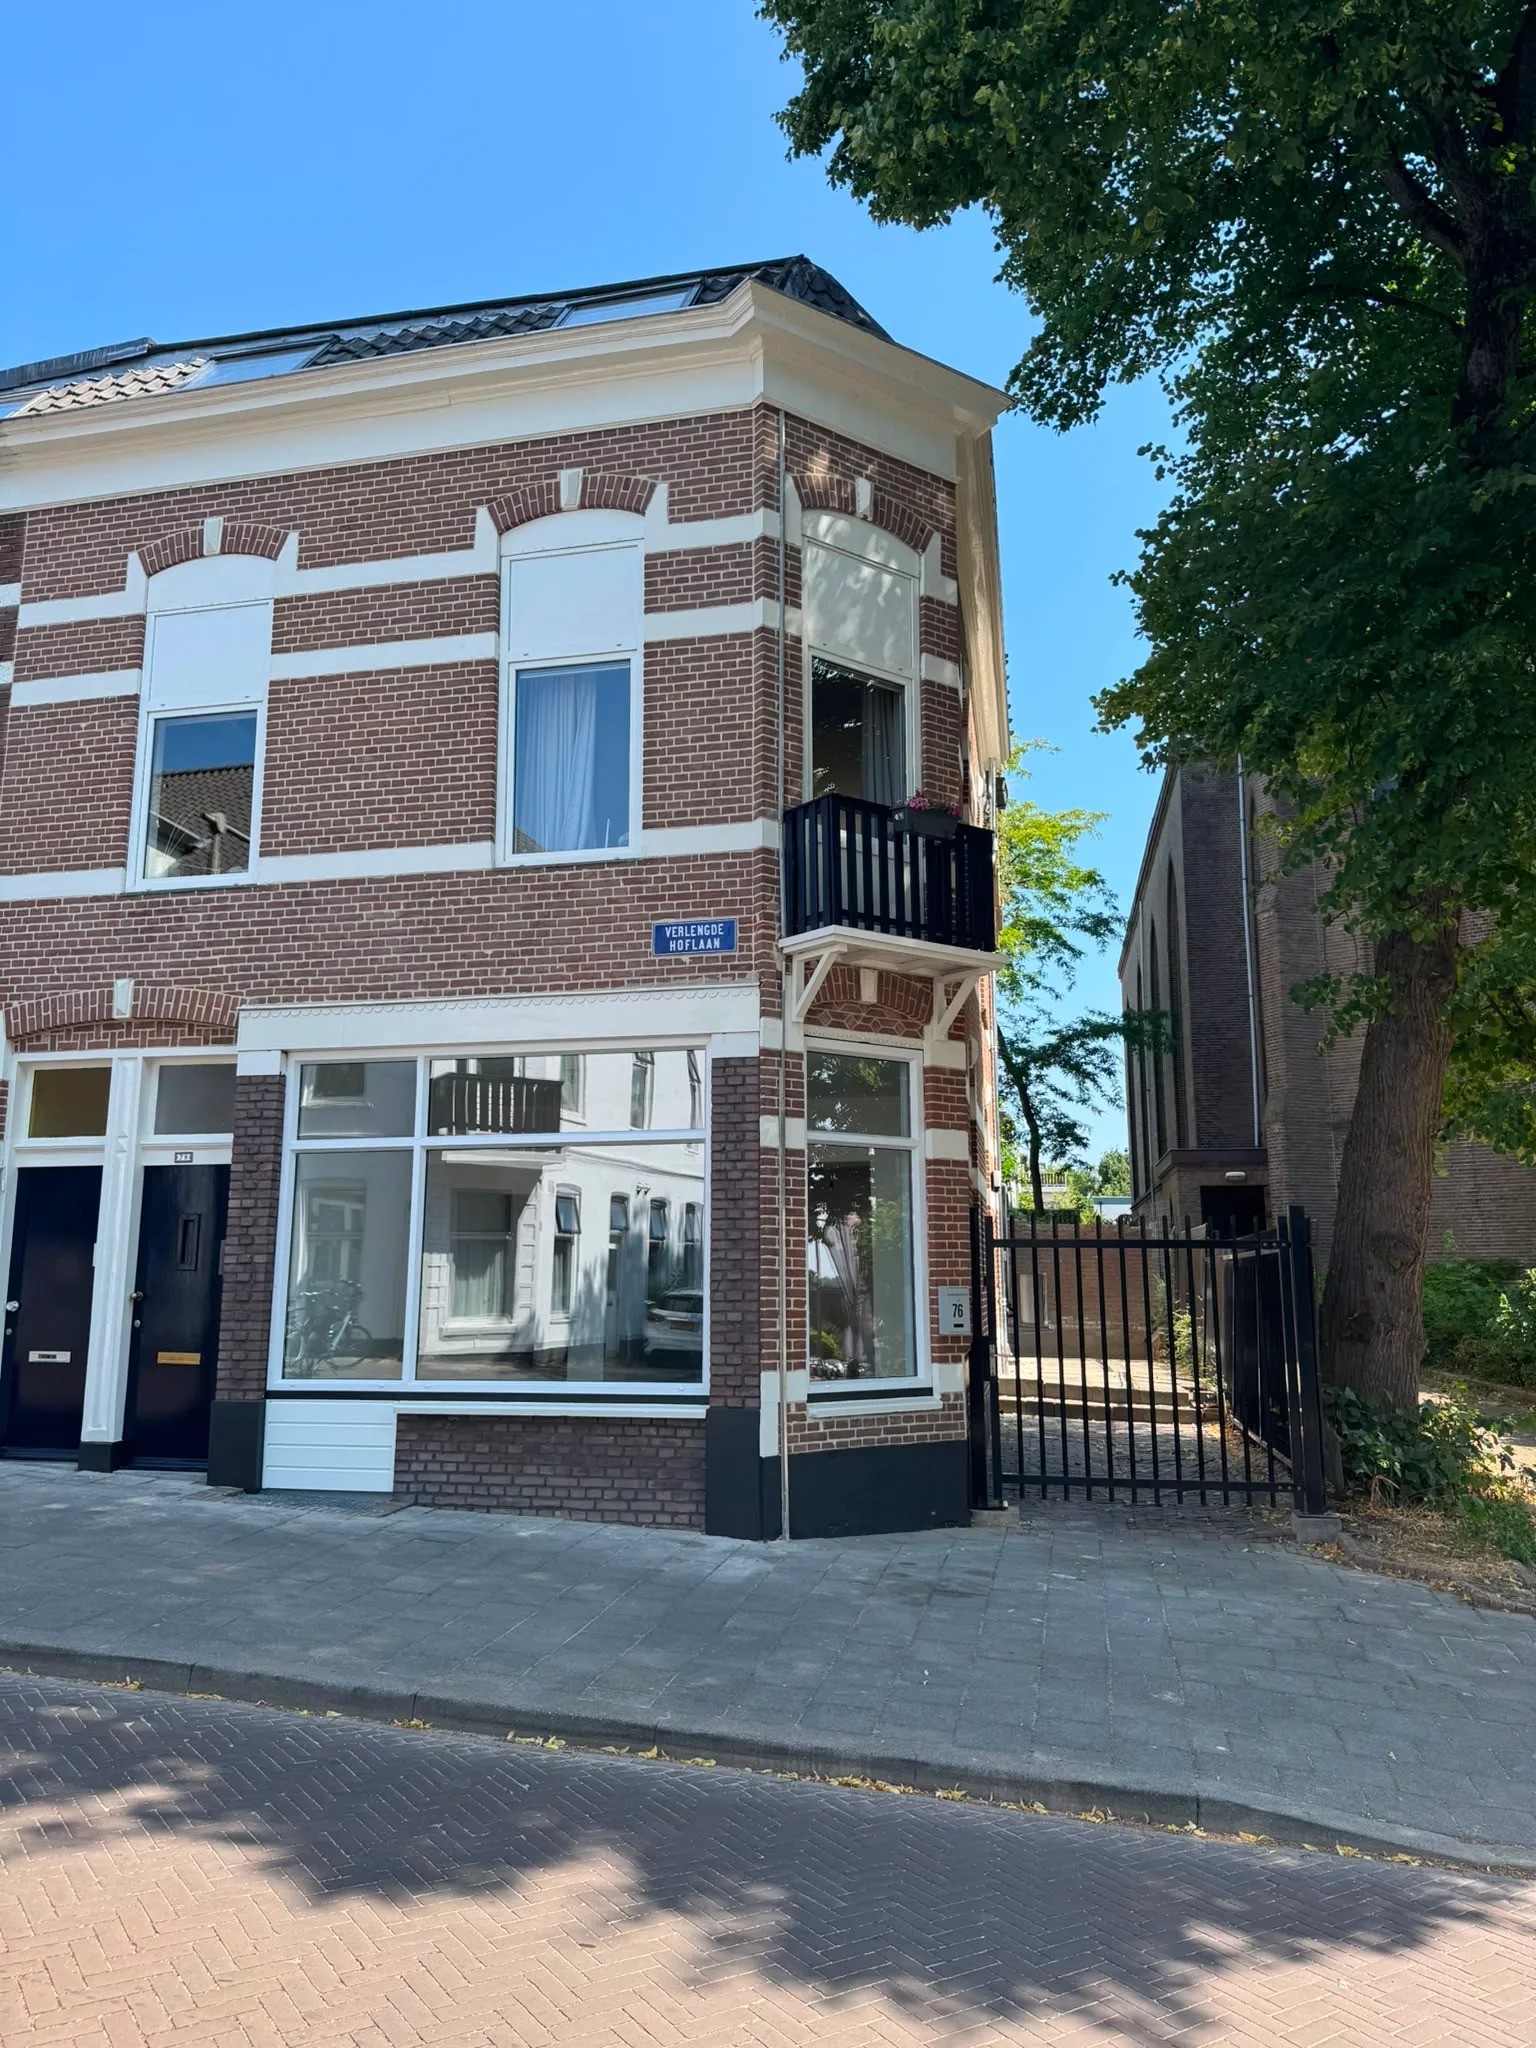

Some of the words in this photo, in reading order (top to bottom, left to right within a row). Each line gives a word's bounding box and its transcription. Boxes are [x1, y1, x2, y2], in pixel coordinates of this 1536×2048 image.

[665, 924, 724, 938] VERLENGDE
[669, 937, 720, 952] HOFLAAN
[952, 1303, 964, 1318] 76
